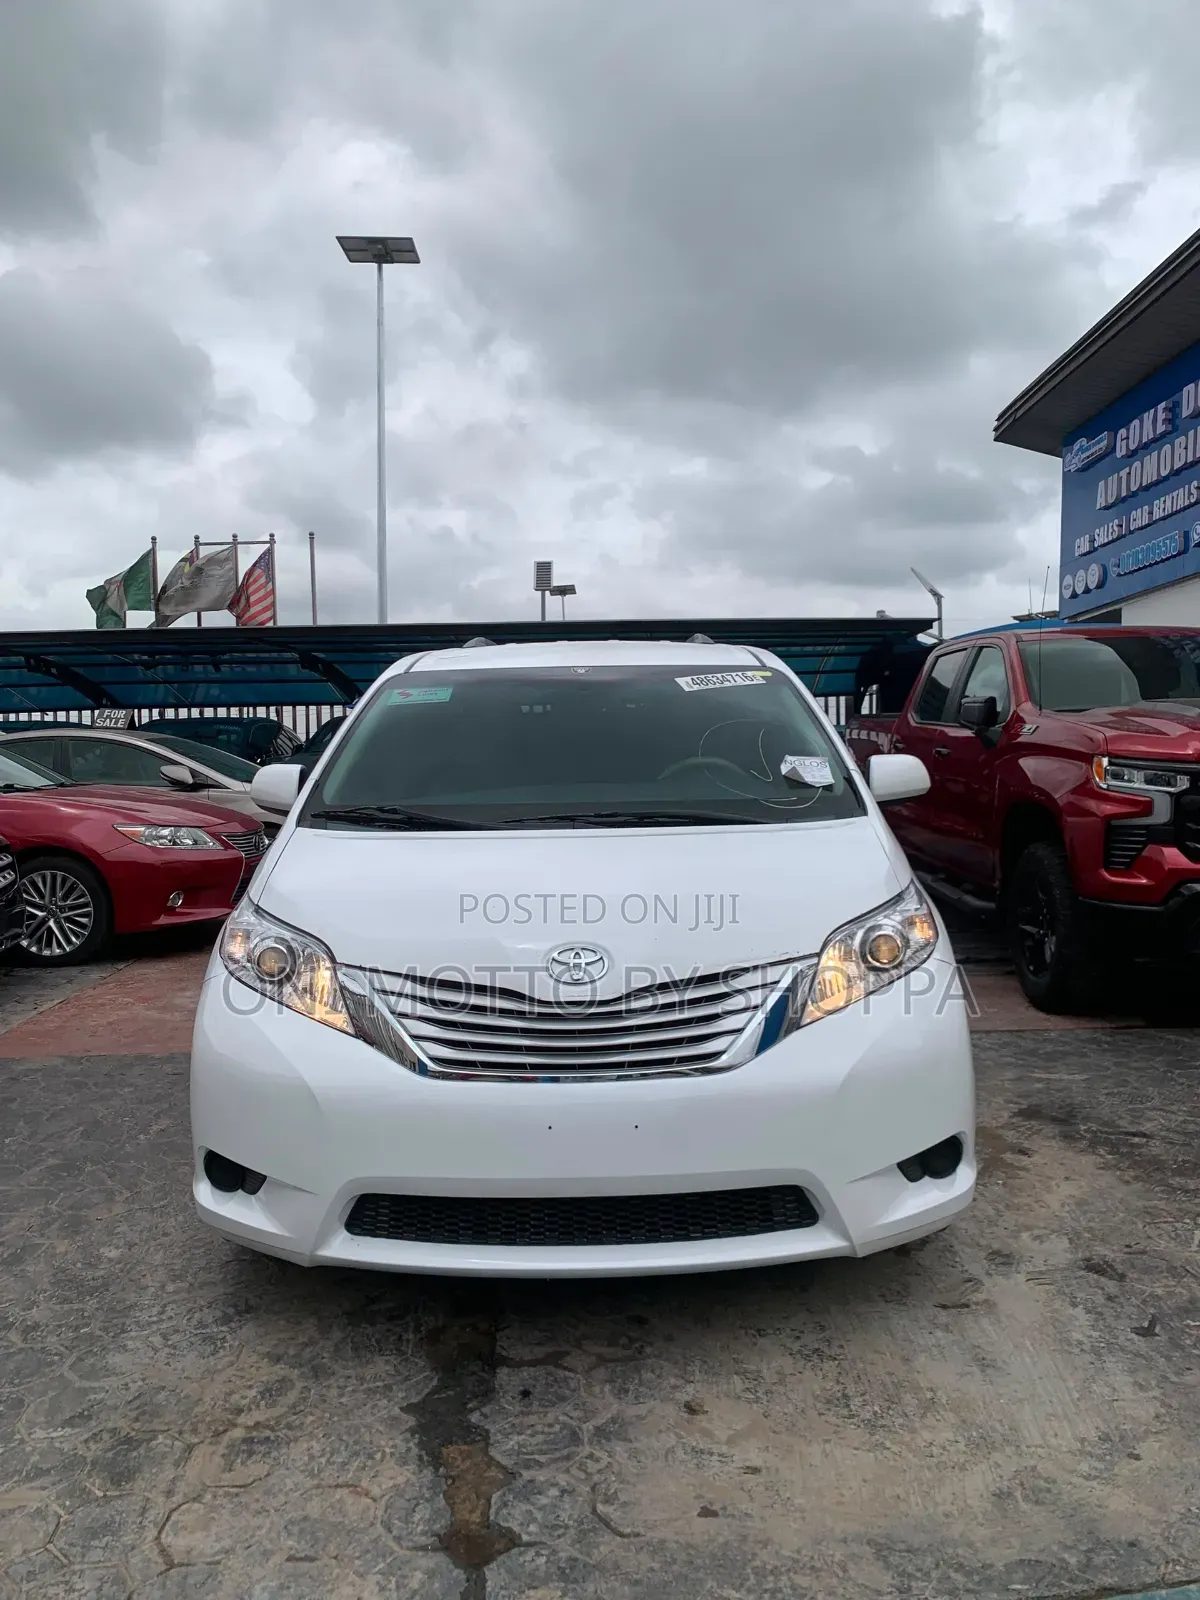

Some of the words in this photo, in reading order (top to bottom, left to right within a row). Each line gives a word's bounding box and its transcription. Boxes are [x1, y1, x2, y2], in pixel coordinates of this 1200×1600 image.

[1115, 400, 1167, 459] GOKE
[1181, 379, 1200, 419] D
[1095, 426, 1200, 511] AUTOMOBI
[1075, 533, 1090, 557] CAR
[1094, 518, 1119, 548] SALES
[1129, 504, 1149, 531] CAR
[1152, 480, 1198, 521] RENTALS
[691, 671, 754, 687] 48634716
[95, 718, 126, 728] SALE
[103, 709, 126, 718] FOR
